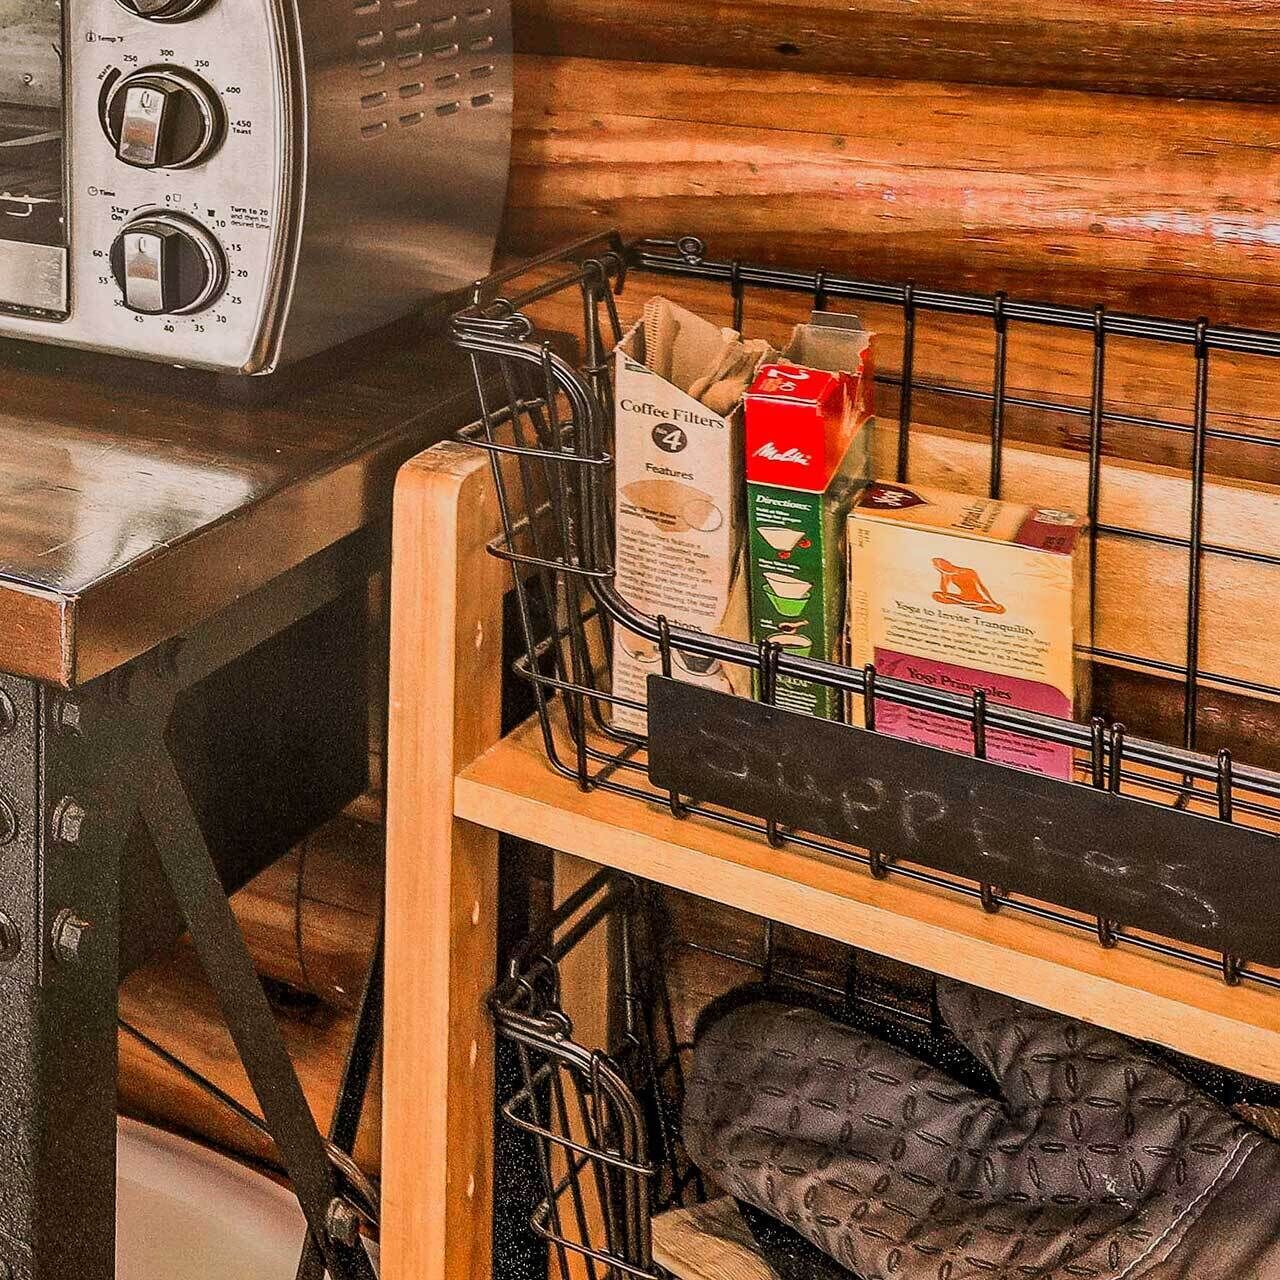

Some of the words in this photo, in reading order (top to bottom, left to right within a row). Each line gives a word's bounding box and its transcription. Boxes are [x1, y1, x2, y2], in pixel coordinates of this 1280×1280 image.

[97, 35, 117, 43] Temp
[159, 49, 175, 57] 300
[123, 54, 138, 62] 250
[194, 60, 210, 68] 350
[235, 120, 252, 128] 450
[165, 194, 171, 202] 0
[193, 202, 199, 210] 5
[111, 205, 130, 216] Stay
[230, 205, 248, 214] Turn
[259, 208, 269, 216] 20
[111, 214, 123, 222] On
[215, 220, 226, 228] 10
[230, 220, 255, 228] desired
[231, 243, 242, 252] 15
[237, 270, 248, 278] 20
[113, 299, 125, 307] 50
[231, 296, 242, 305] 25
[134, 315, 145, 323] 45
[216, 315, 227, 323] 30
[163, 324, 175, 333] 40
[194, 324, 205, 332] 35
[620, 399, 670, 420] Coffee
[673, 408, 725, 430] Filters
[662, 429, 682, 450] 4
[645, 462, 695, 480] Features
[895, 600, 920, 614] Yoga
[924, 607, 935, 617] to
[938, 610, 970, 623] Invite
[973, 616, 1036, 636] Tranquility
[907, 667, 937, 684] Yogi
